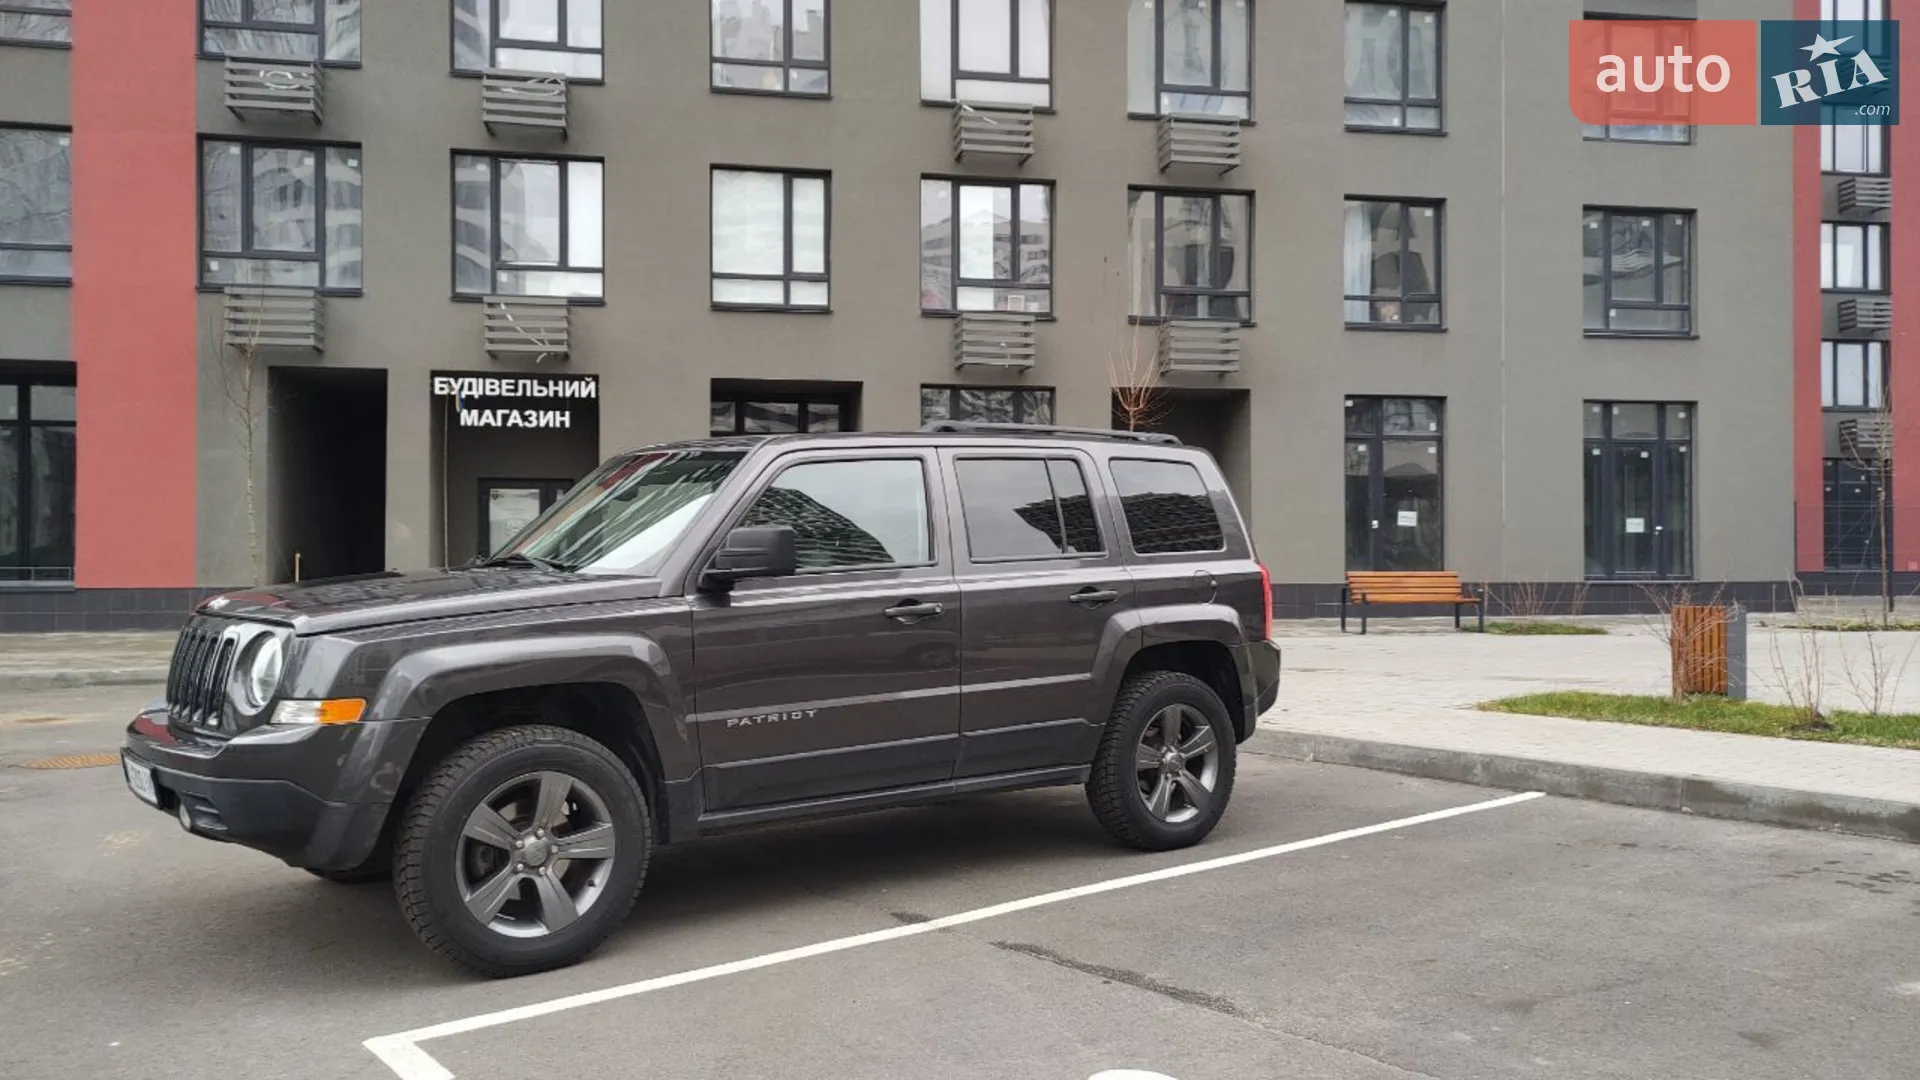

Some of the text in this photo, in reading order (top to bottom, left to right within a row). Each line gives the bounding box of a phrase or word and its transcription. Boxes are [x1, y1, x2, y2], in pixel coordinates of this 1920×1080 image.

[433, 376, 597, 399] БУДІВЕЛЬНИЙ
[460, 409, 571, 429] МАГАЗИН
[726, 709, 817, 728] PATRIOT
